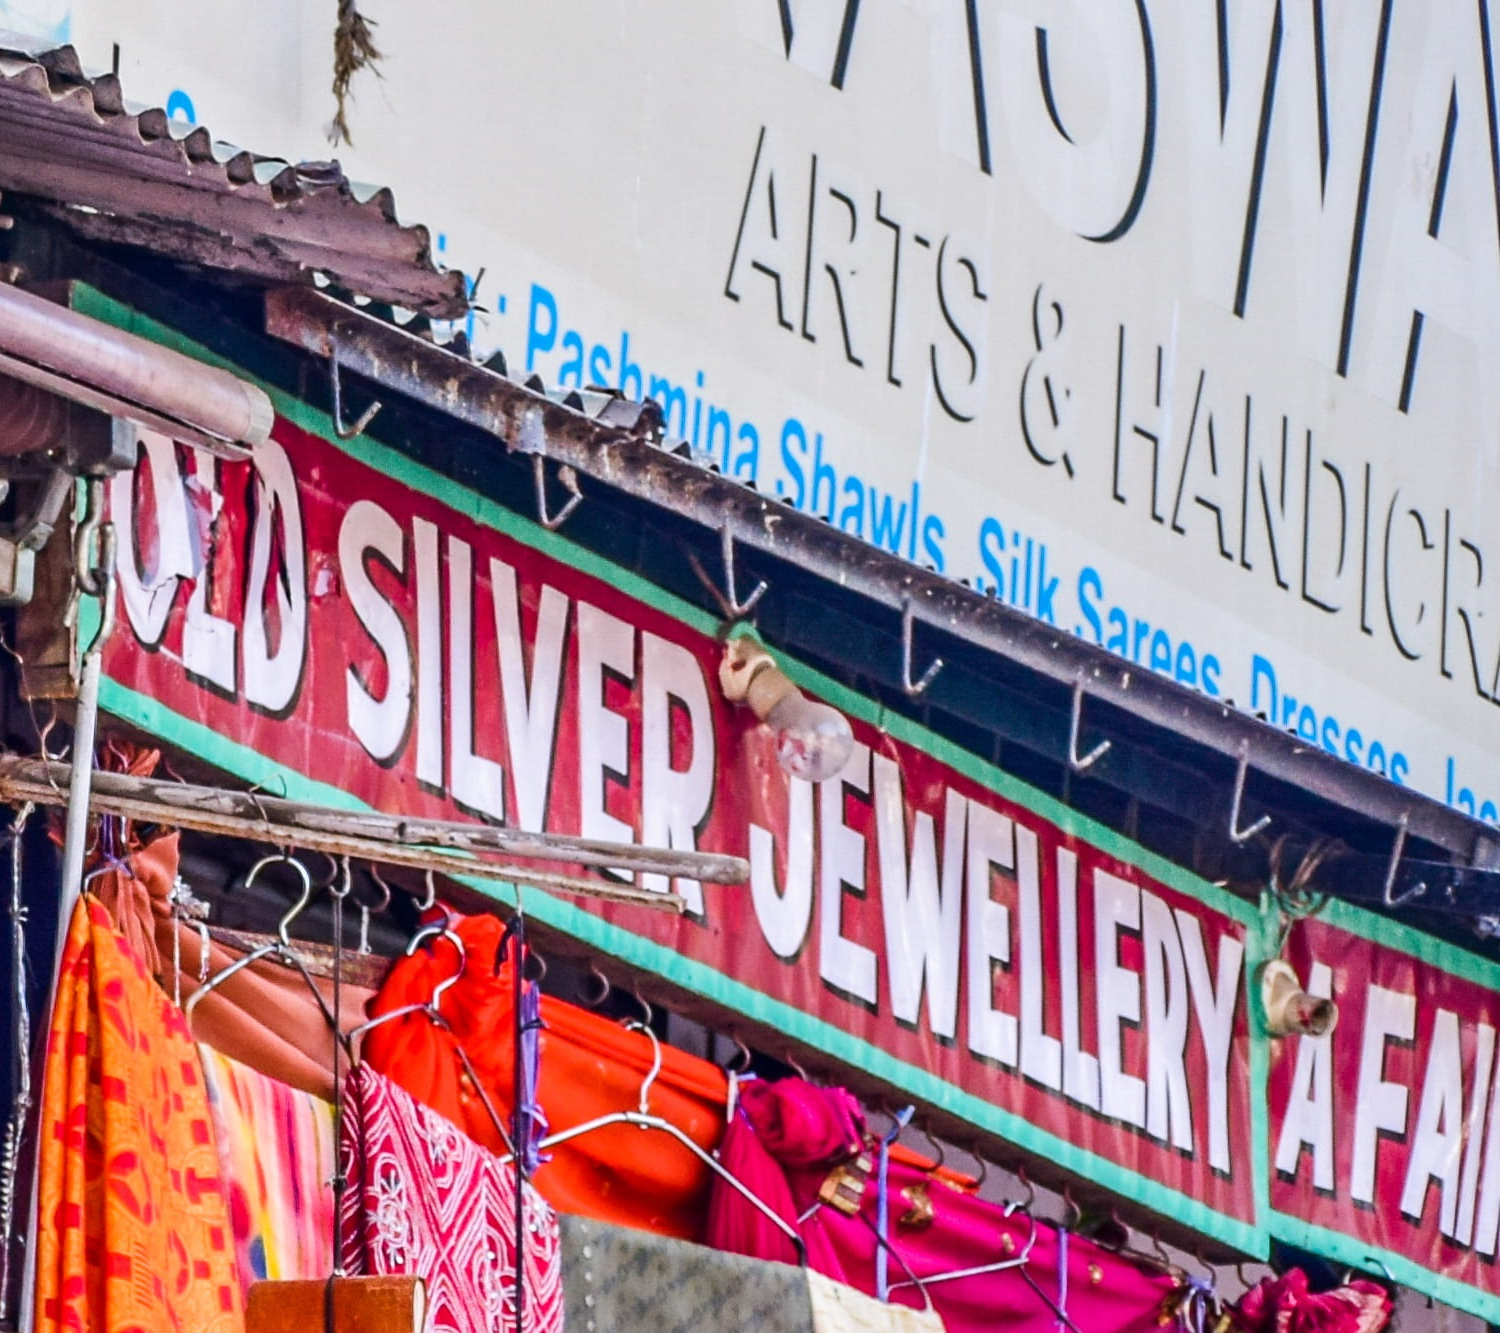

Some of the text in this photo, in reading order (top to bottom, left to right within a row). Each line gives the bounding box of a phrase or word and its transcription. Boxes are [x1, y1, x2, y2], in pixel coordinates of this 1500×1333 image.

[524, 281, 760, 492] Pashmina
[724, 124, 990, 423] ARTS
[1019, 282, 1078, 481] &
[1111, 322, 1500, 706] HANDICR
[338, 499, 716, 926] SILVER
[748, 736, 1248, 1180] JEWELLERY
[1274, 960, 1500, 1266] A FAI
